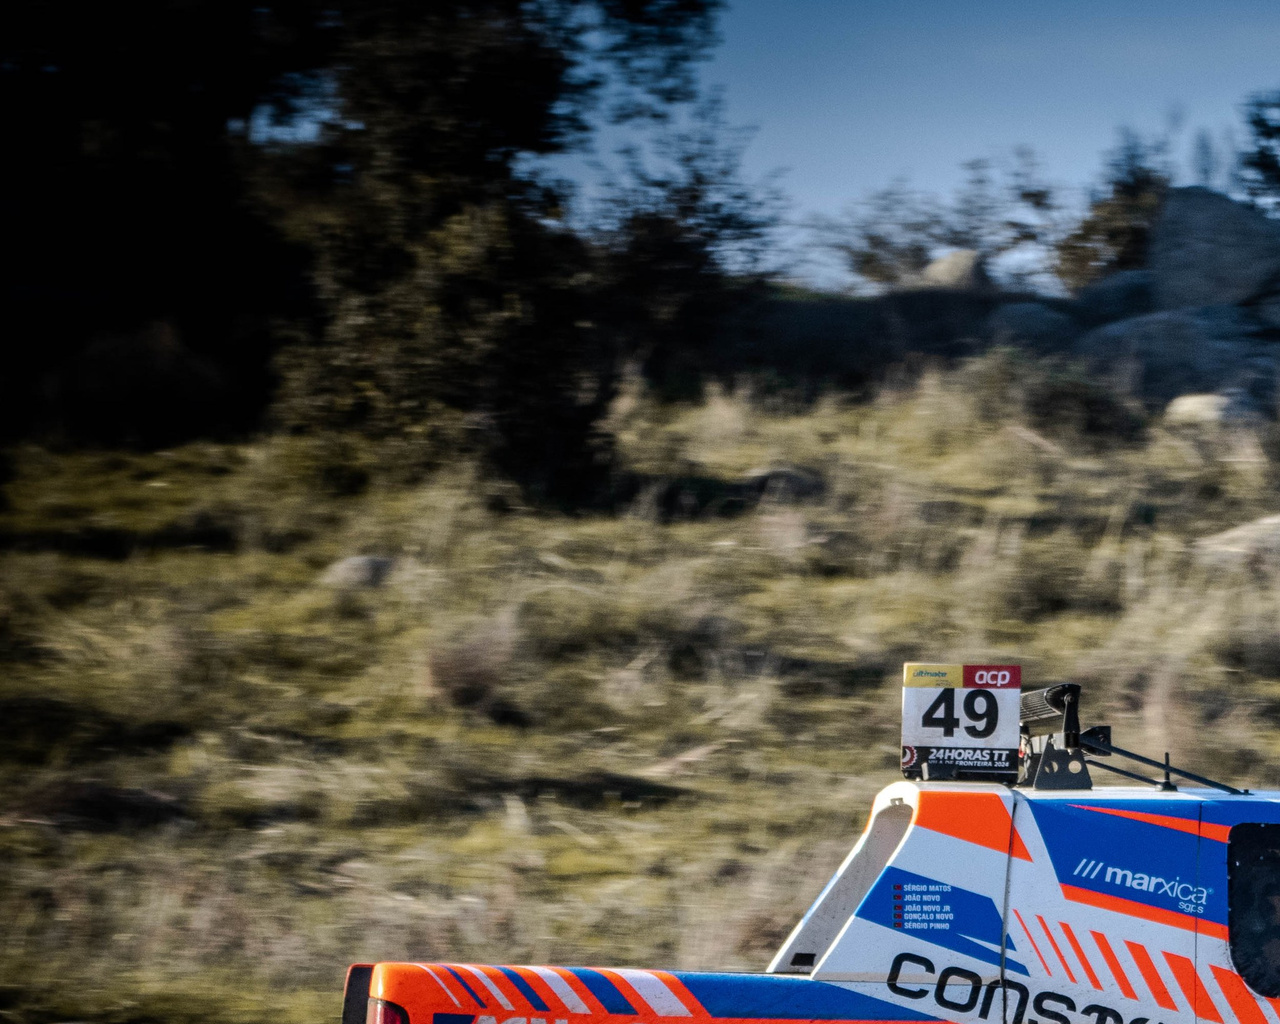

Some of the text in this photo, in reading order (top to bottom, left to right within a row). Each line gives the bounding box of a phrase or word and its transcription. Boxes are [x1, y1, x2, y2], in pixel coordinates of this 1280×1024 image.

[975, 670, 1011, 687] acp
[922, 688, 999, 739] 49
[992, 750, 1010, 761] TT
[903, 883, 928, 892] SÉRGIO
[1105, 866, 1207, 905] marxica
[903, 893, 921, 901] JOÃO
[903, 904, 921, 912] JOÃO
[903, 913, 934, 921] GONÇALO
[904, 921, 928, 929] SÉRGIO
